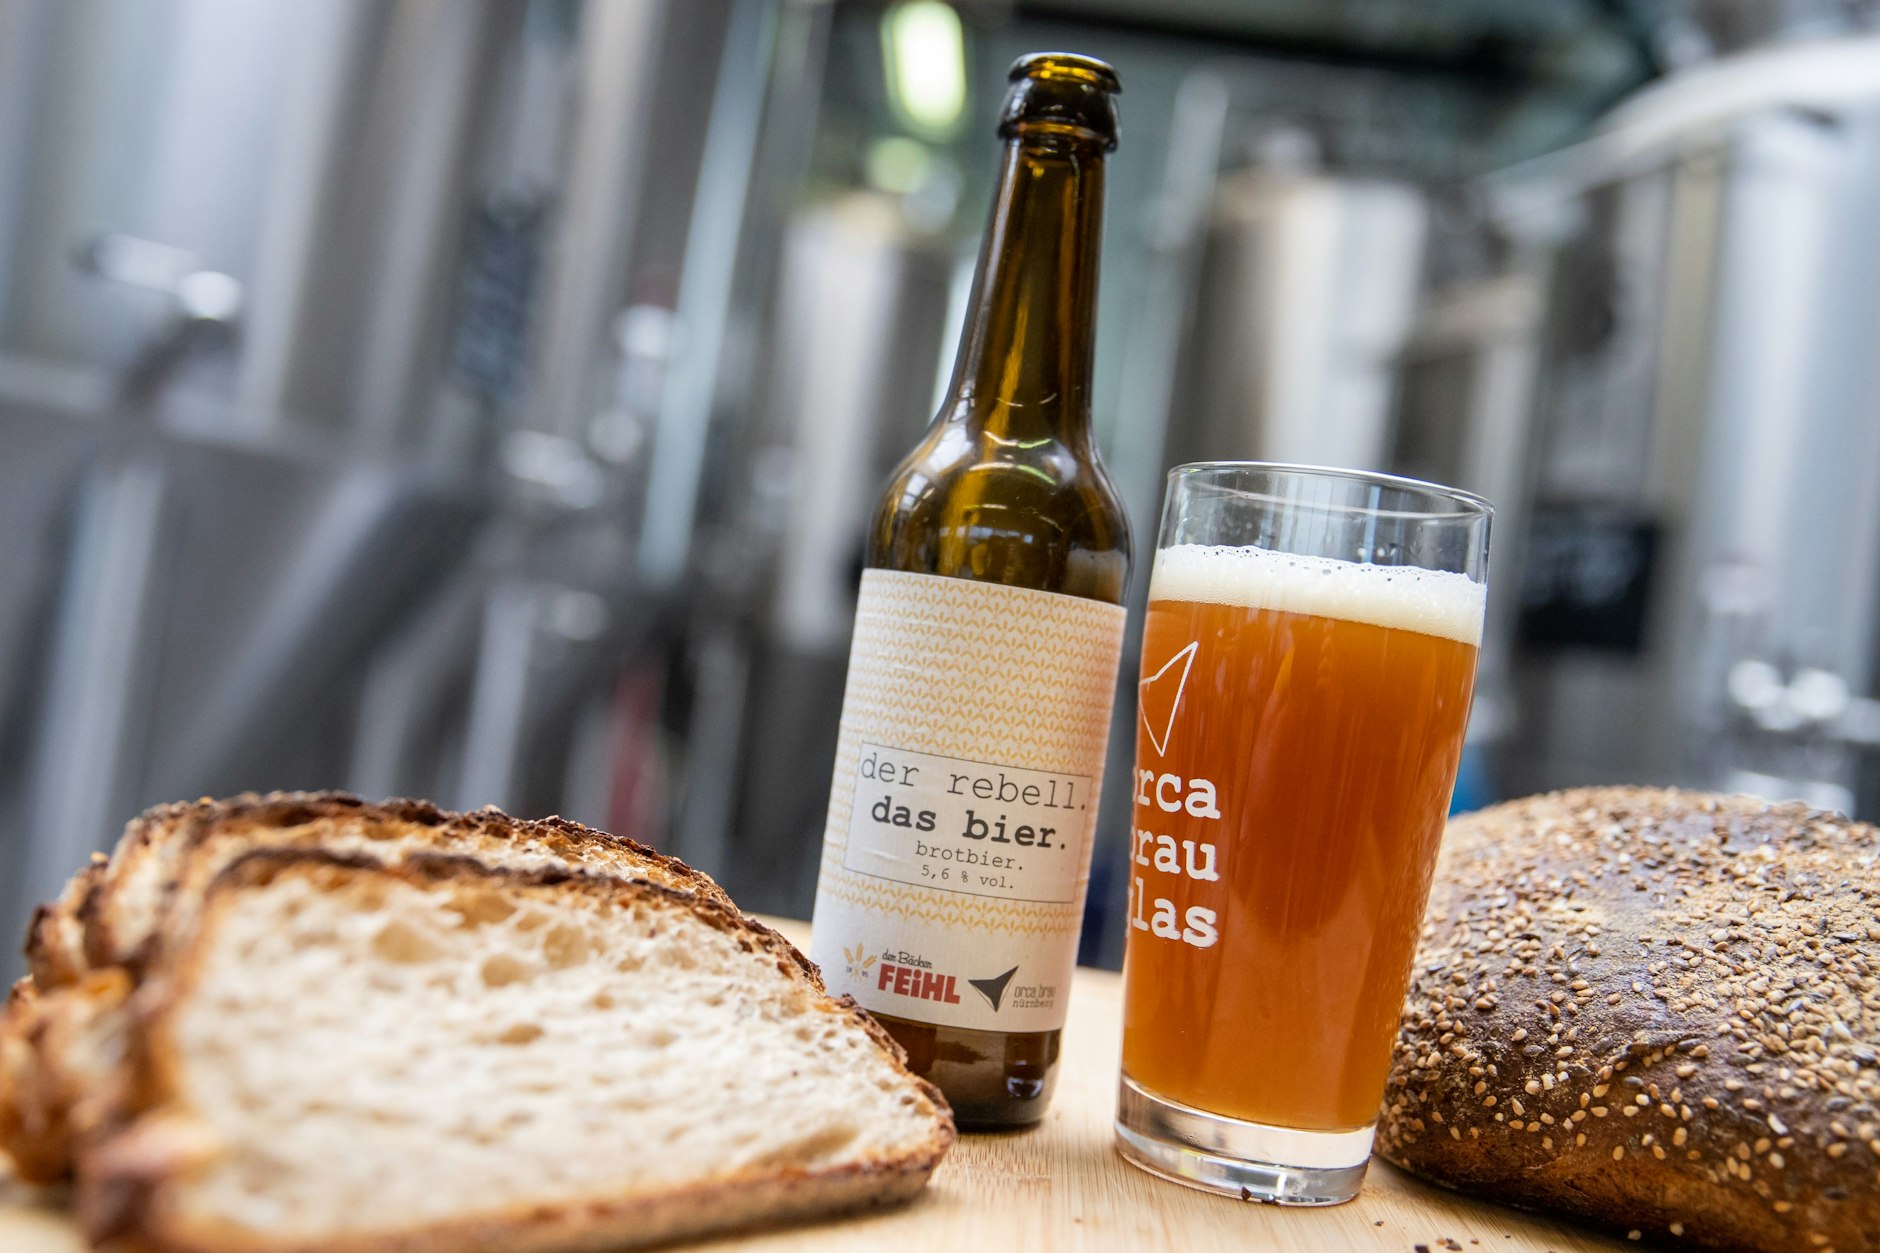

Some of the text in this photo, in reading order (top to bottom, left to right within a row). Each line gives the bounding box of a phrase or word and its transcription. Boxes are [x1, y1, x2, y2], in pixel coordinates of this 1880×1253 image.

[861, 752, 1086, 811] der rebell.
[1132, 766, 1220, 819] rca
[872, 795, 1066, 850] das bier.
[915, 841, 1023, 870] brotbier.
[921, 864, 1014, 889] 5,6 % vol.
[1125, 873, 1218, 948] las
[1014, 985, 1036, 998] orca
